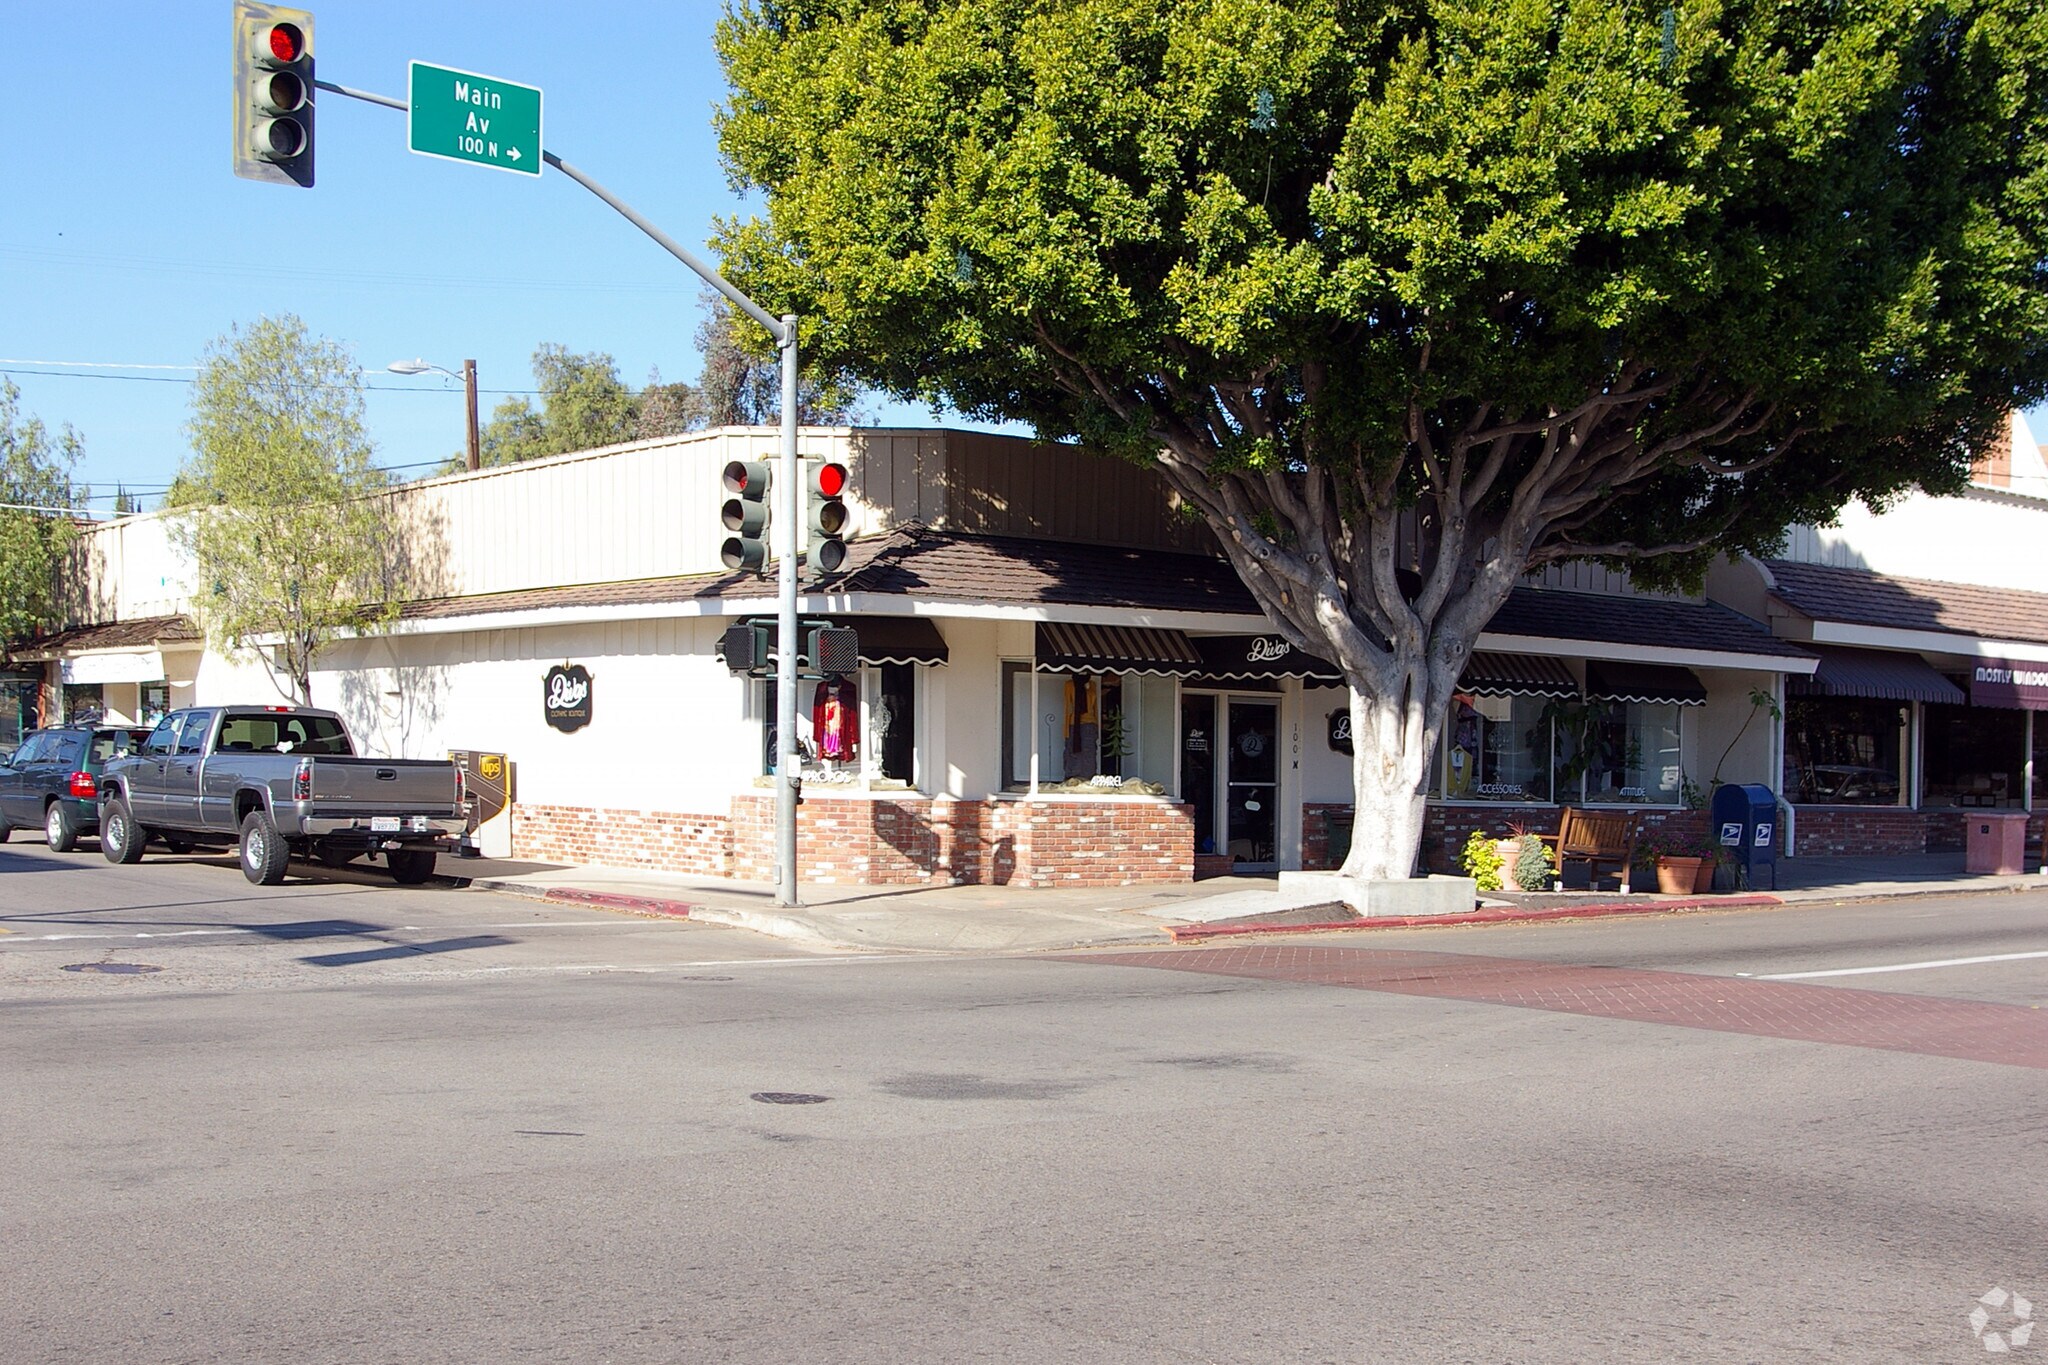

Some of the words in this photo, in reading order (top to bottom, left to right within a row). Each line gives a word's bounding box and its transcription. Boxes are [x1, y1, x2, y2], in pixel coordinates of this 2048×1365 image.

[455, 80, 501, 110] Main
[466, 111, 490, 135] Av
[458, 135, 484, 155] 100
[488, 141, 498, 158] N
[1246, 637, 1290, 662] Divas
[1976, 666, 2012, 684] MOSTLY
[2013, 669, 2048, 687] WINDO
[547, 673, 588, 709] Divas
[483, 762, 500, 777] ups
[1090, 775, 1123, 787] APPAREL
[1476, 783, 1522, 795] ACCESSORIES
[1619, 786, 1646, 797] ATTITUDE
